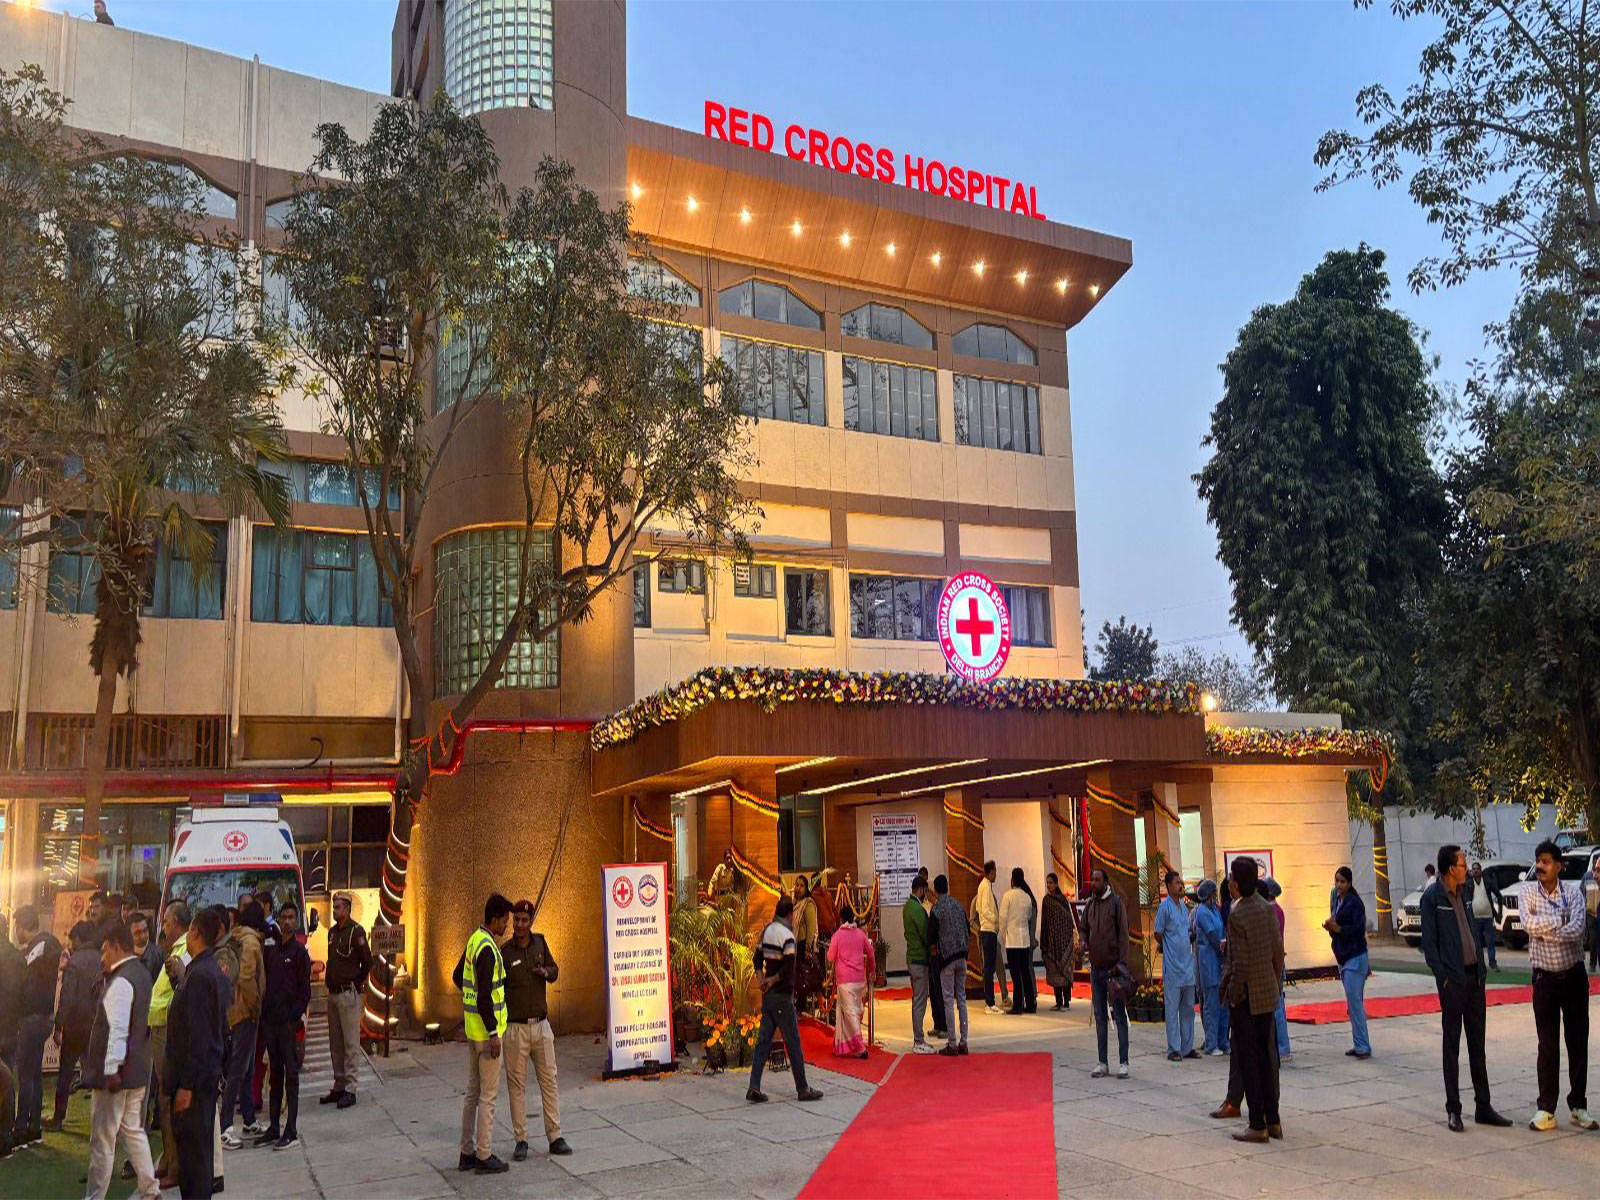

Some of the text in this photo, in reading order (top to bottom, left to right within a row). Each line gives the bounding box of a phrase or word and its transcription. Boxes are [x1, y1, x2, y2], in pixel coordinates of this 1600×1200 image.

[704, 101, 1046, 221] RED CROSS HOSPITAL
[940, 575, 1009, 641] INDIAN RED CROSS SOCIETY
[950, 653, 1004, 679] DELHI BRANCH
